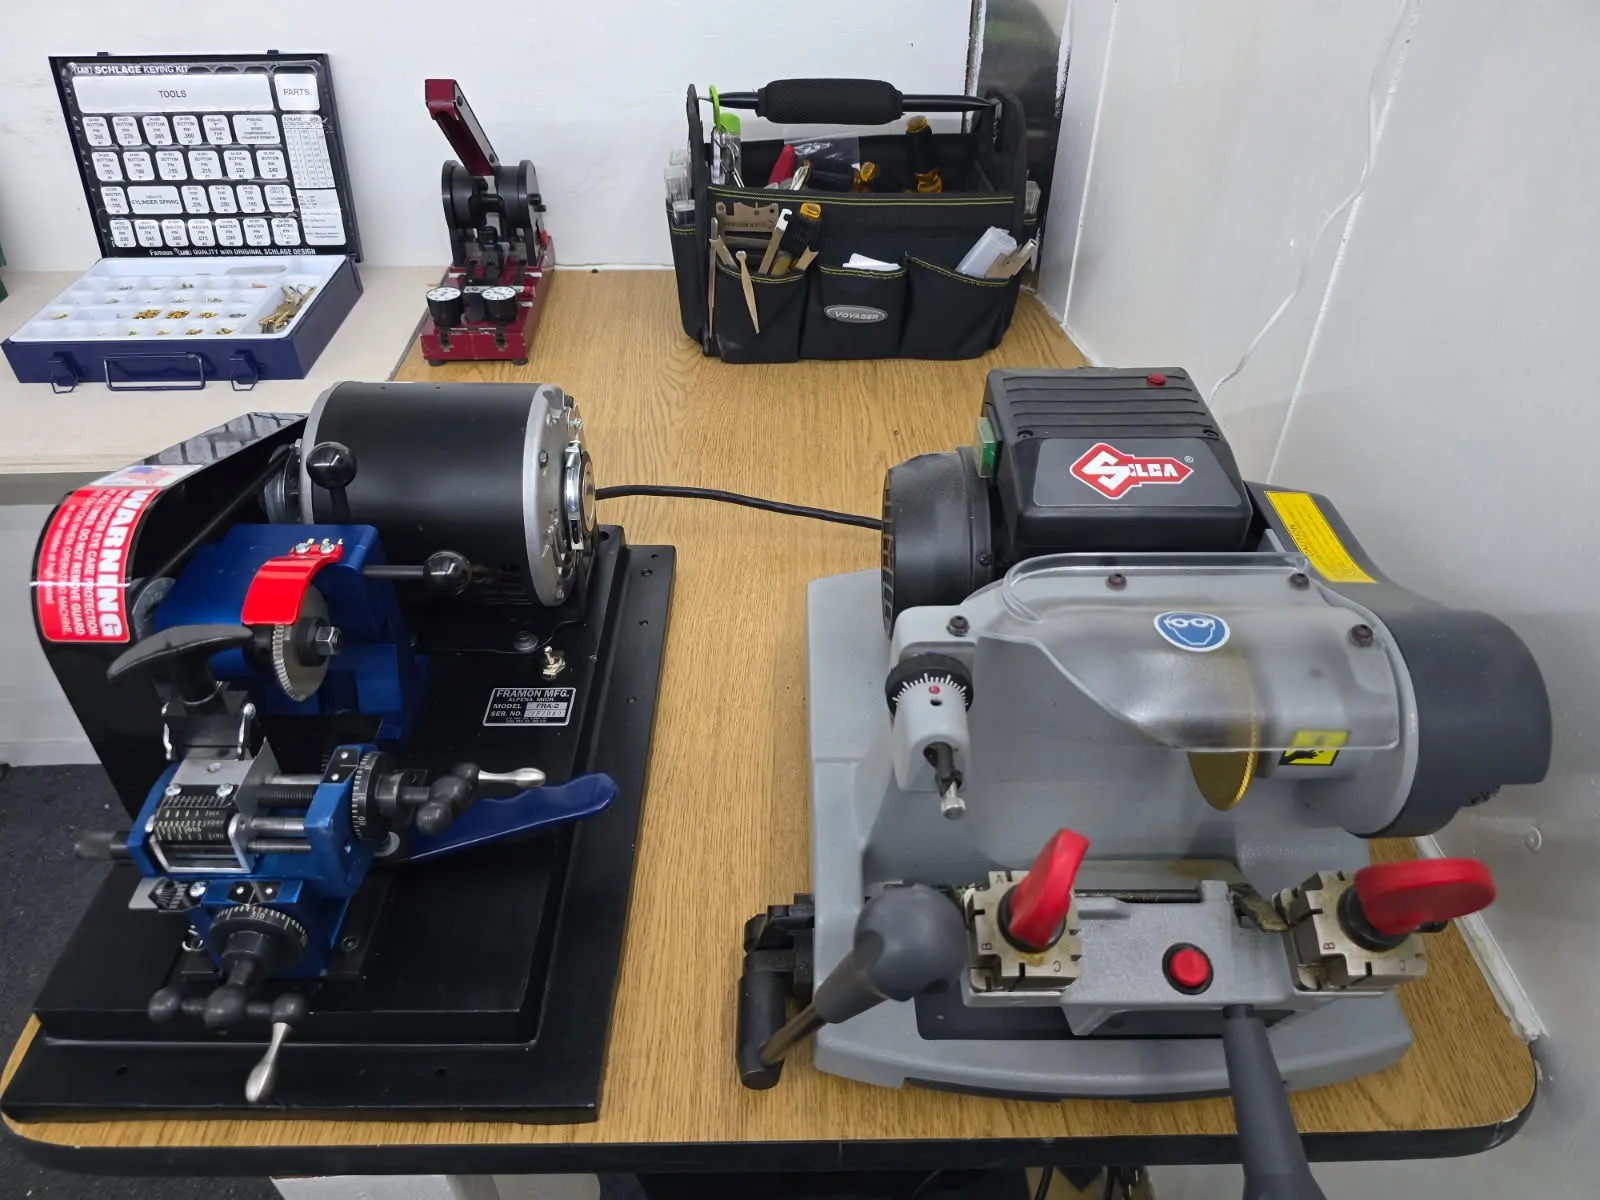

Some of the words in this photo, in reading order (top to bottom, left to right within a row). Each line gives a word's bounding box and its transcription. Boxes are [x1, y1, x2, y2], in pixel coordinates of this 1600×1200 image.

[94, 66, 141, 74] SCHLAGE
[835, 311, 879, 320] VOYAGER
[1080, 450, 1179, 491] SILCA
[71, 497, 96, 523] CAUTION
[94, 495, 110, 505] ALL
[94, 504, 115, 531] PROPER
[62, 524, 78, 545] WHEN
[77, 528, 89, 541] DO
[87, 533, 102, 549] EYE
[1289, 524, 1314, 557] CAUTION
[72, 542, 85, 560] NOT
[43, 562, 56, 579] high
[83, 550, 97, 576] CARE
[96, 489, 156, 636] WARNING
[70, 562, 81, 601] REMOVE
[83, 578, 98, 635] PROTECTION
[70, 603, 84, 635] GUARD
[496, 690, 541, 698] FRAMON
[1053, 960, 1061, 972] C
